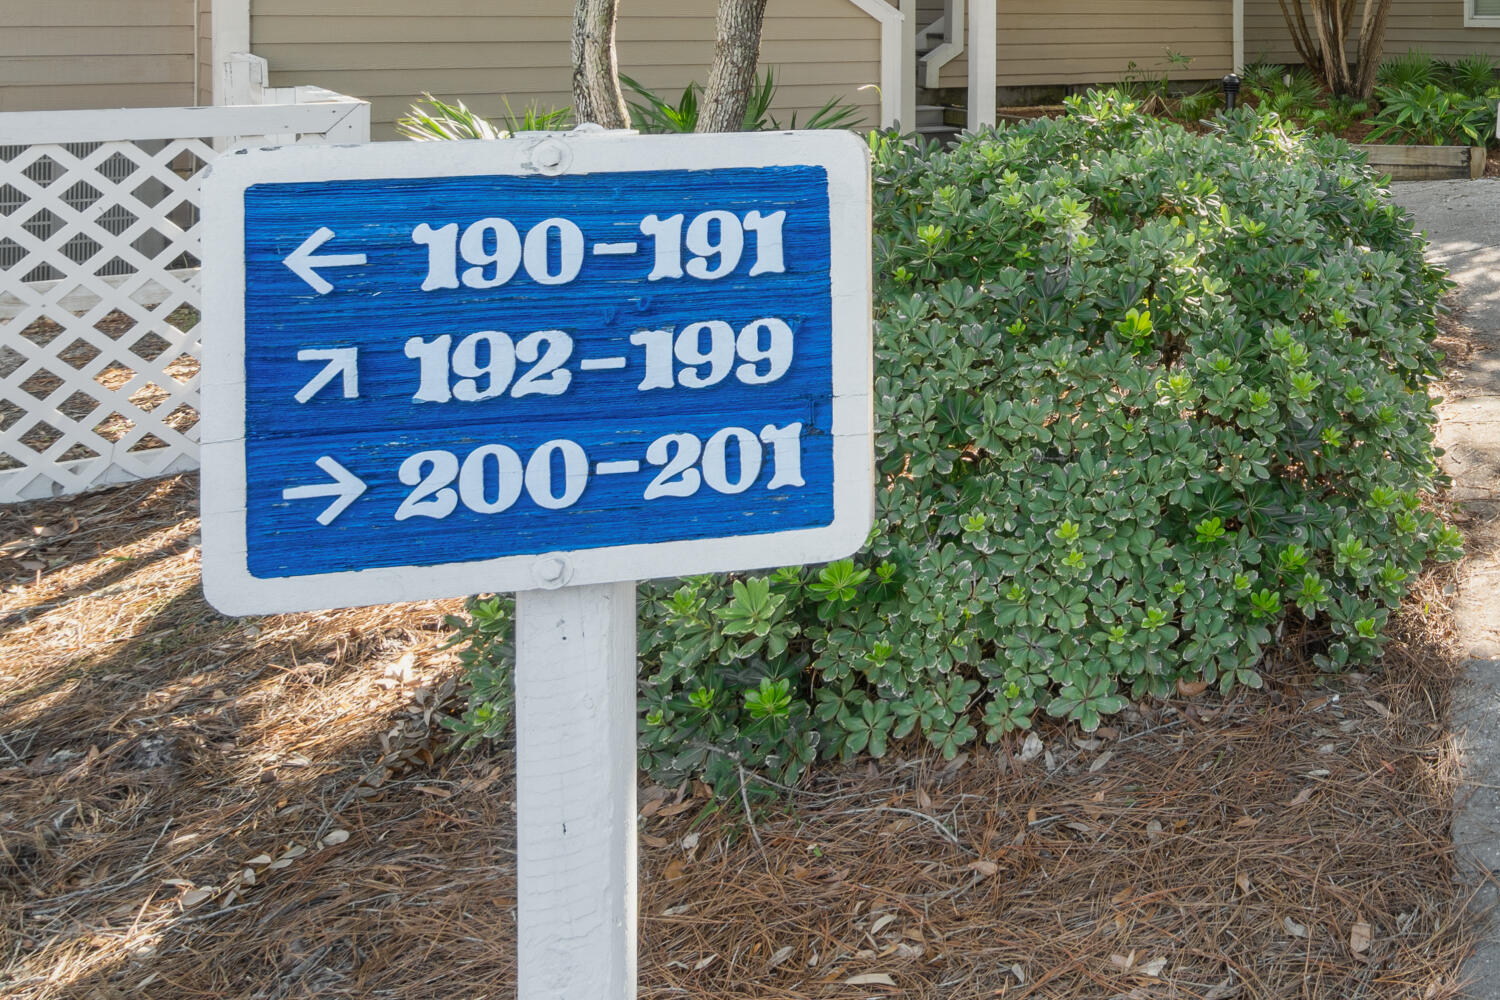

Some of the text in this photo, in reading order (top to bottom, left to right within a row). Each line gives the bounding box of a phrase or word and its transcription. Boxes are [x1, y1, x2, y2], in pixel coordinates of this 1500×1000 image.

[411, 209, 787, 292] 190-191
[404, 317, 795, 404] 192-199
[394, 421, 806, 521] 200-201
